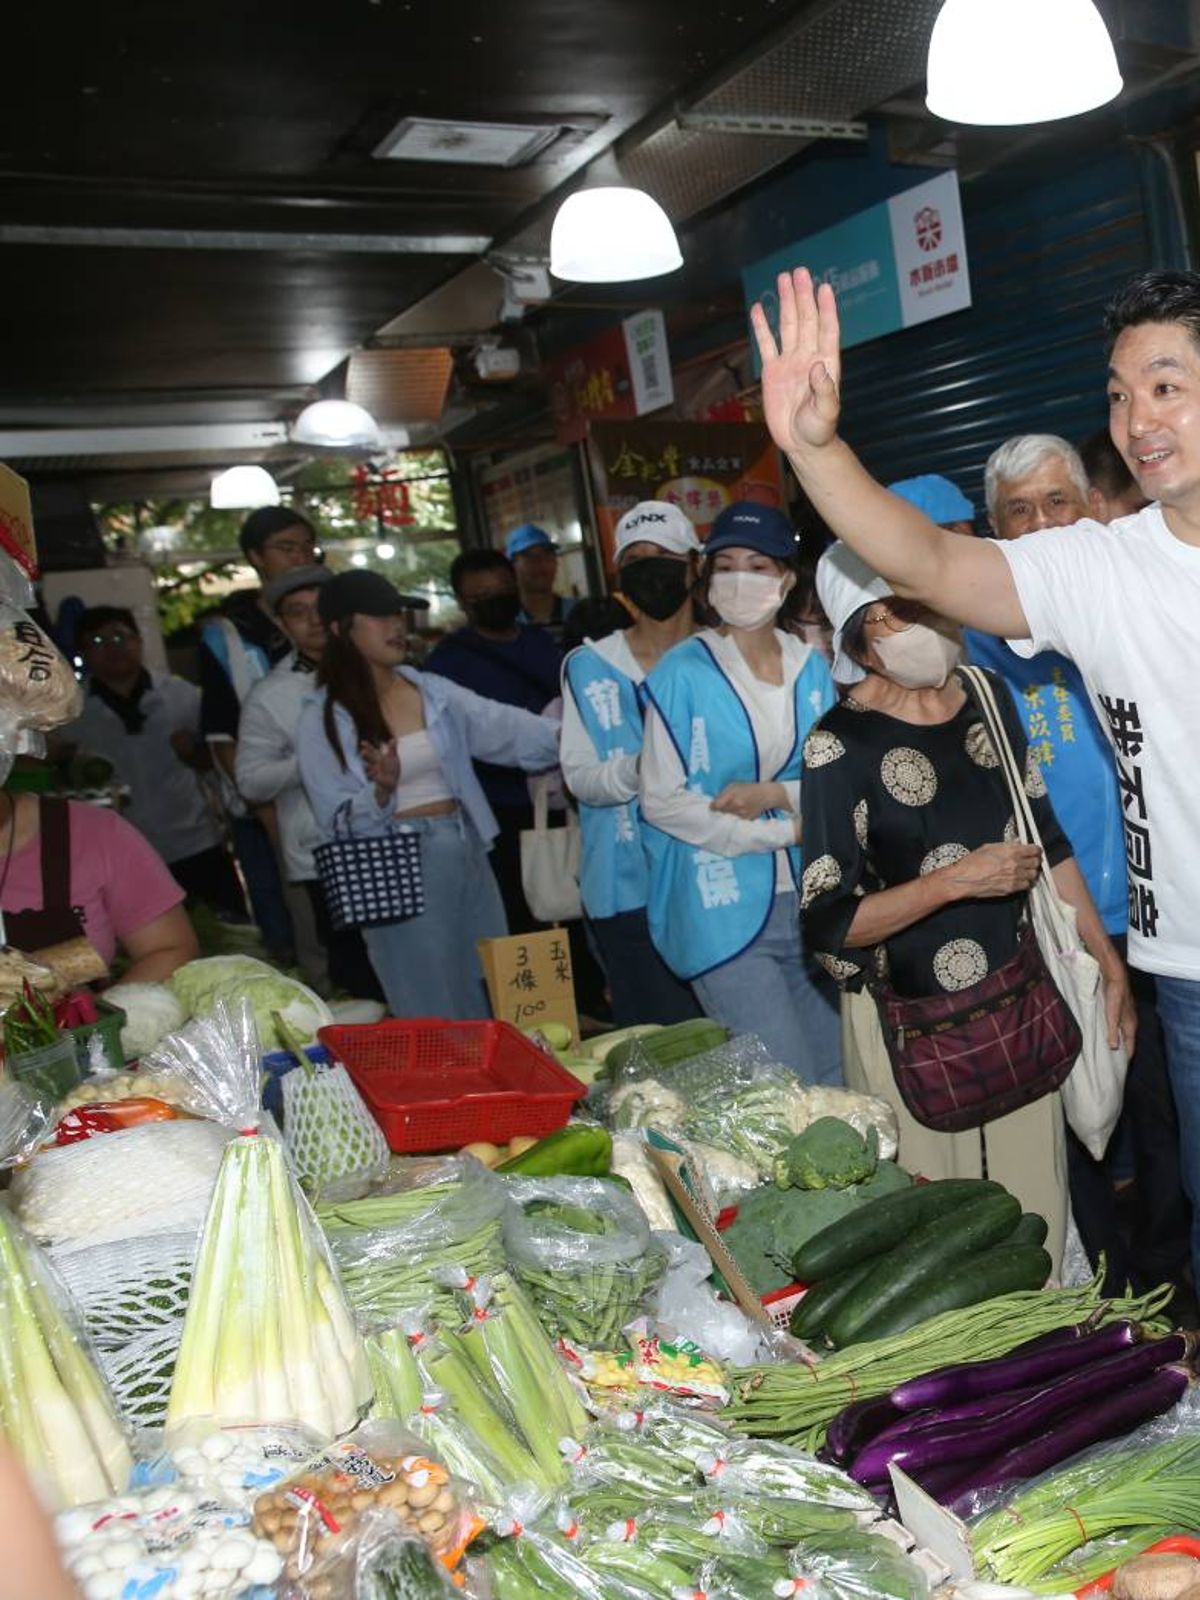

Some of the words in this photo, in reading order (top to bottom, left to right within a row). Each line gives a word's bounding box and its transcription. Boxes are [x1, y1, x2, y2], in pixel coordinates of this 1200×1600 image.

[624, 512, 668, 530] LYNX
[550, 941, 571, 982] 玉米
[515, 1001, 546, 1024] 100
